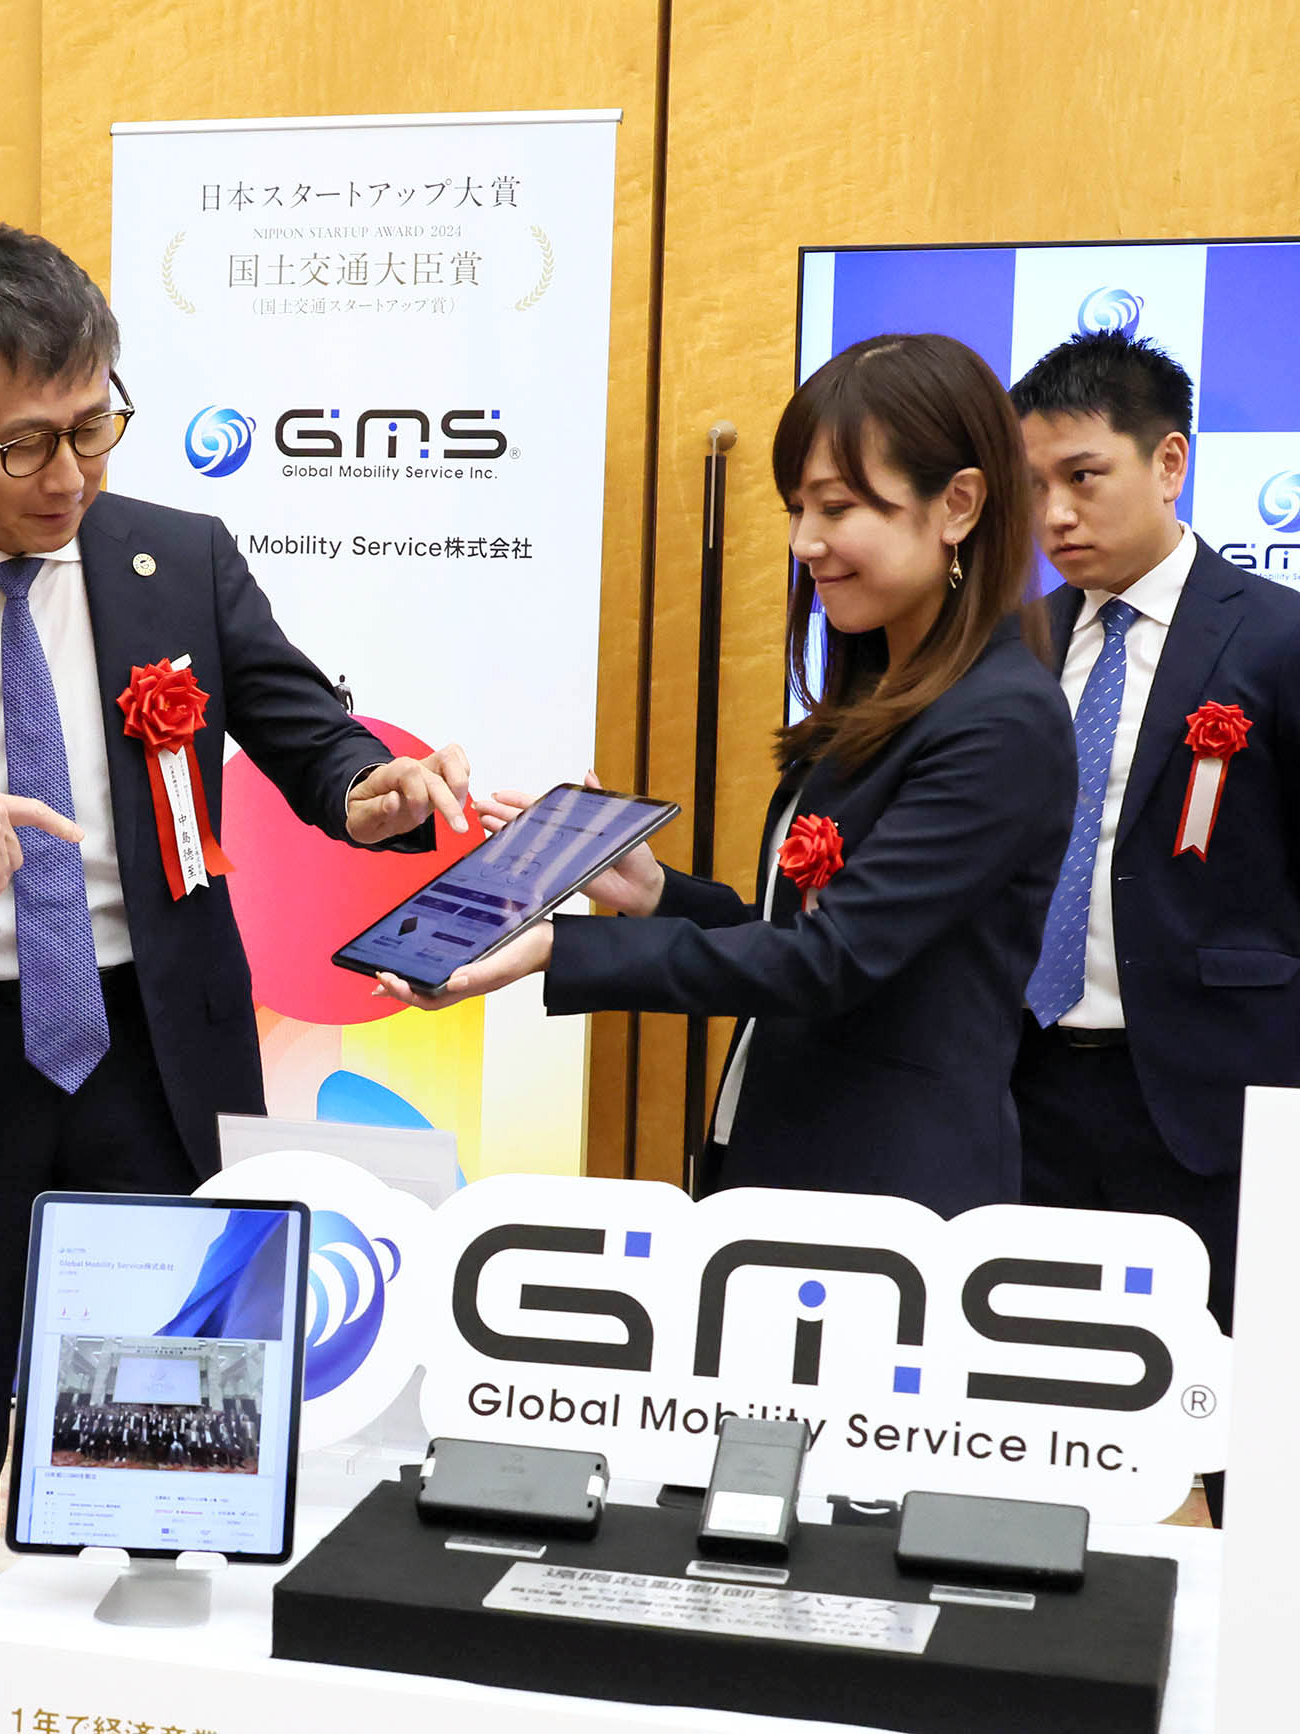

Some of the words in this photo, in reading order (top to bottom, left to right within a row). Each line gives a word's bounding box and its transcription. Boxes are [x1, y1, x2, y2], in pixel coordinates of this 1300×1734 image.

[202, 176, 521, 212] 日本スタートアップ大賞
[253, 227, 304, 240] NIPPON
[309, 226, 369, 239] STARTUP
[375, 225, 424, 238] AWARD
[431, 224, 462, 238] 2024
[228, 251, 483, 288] 国土交通大臣賞
[282, 465, 333, 477] Global
[339, 465, 400, 480] Mobility
[406, 466, 463, 479] Service
[469, 466, 498, 480] Inc.
[249, 535, 343, 559] Mobility
[352, 536, 533, 560] Service株式会社
[468, 1383, 620, 1429] Global
[846, 1414, 1028, 1461] Service
[1050, 1430, 1139, 1473] Inc.
